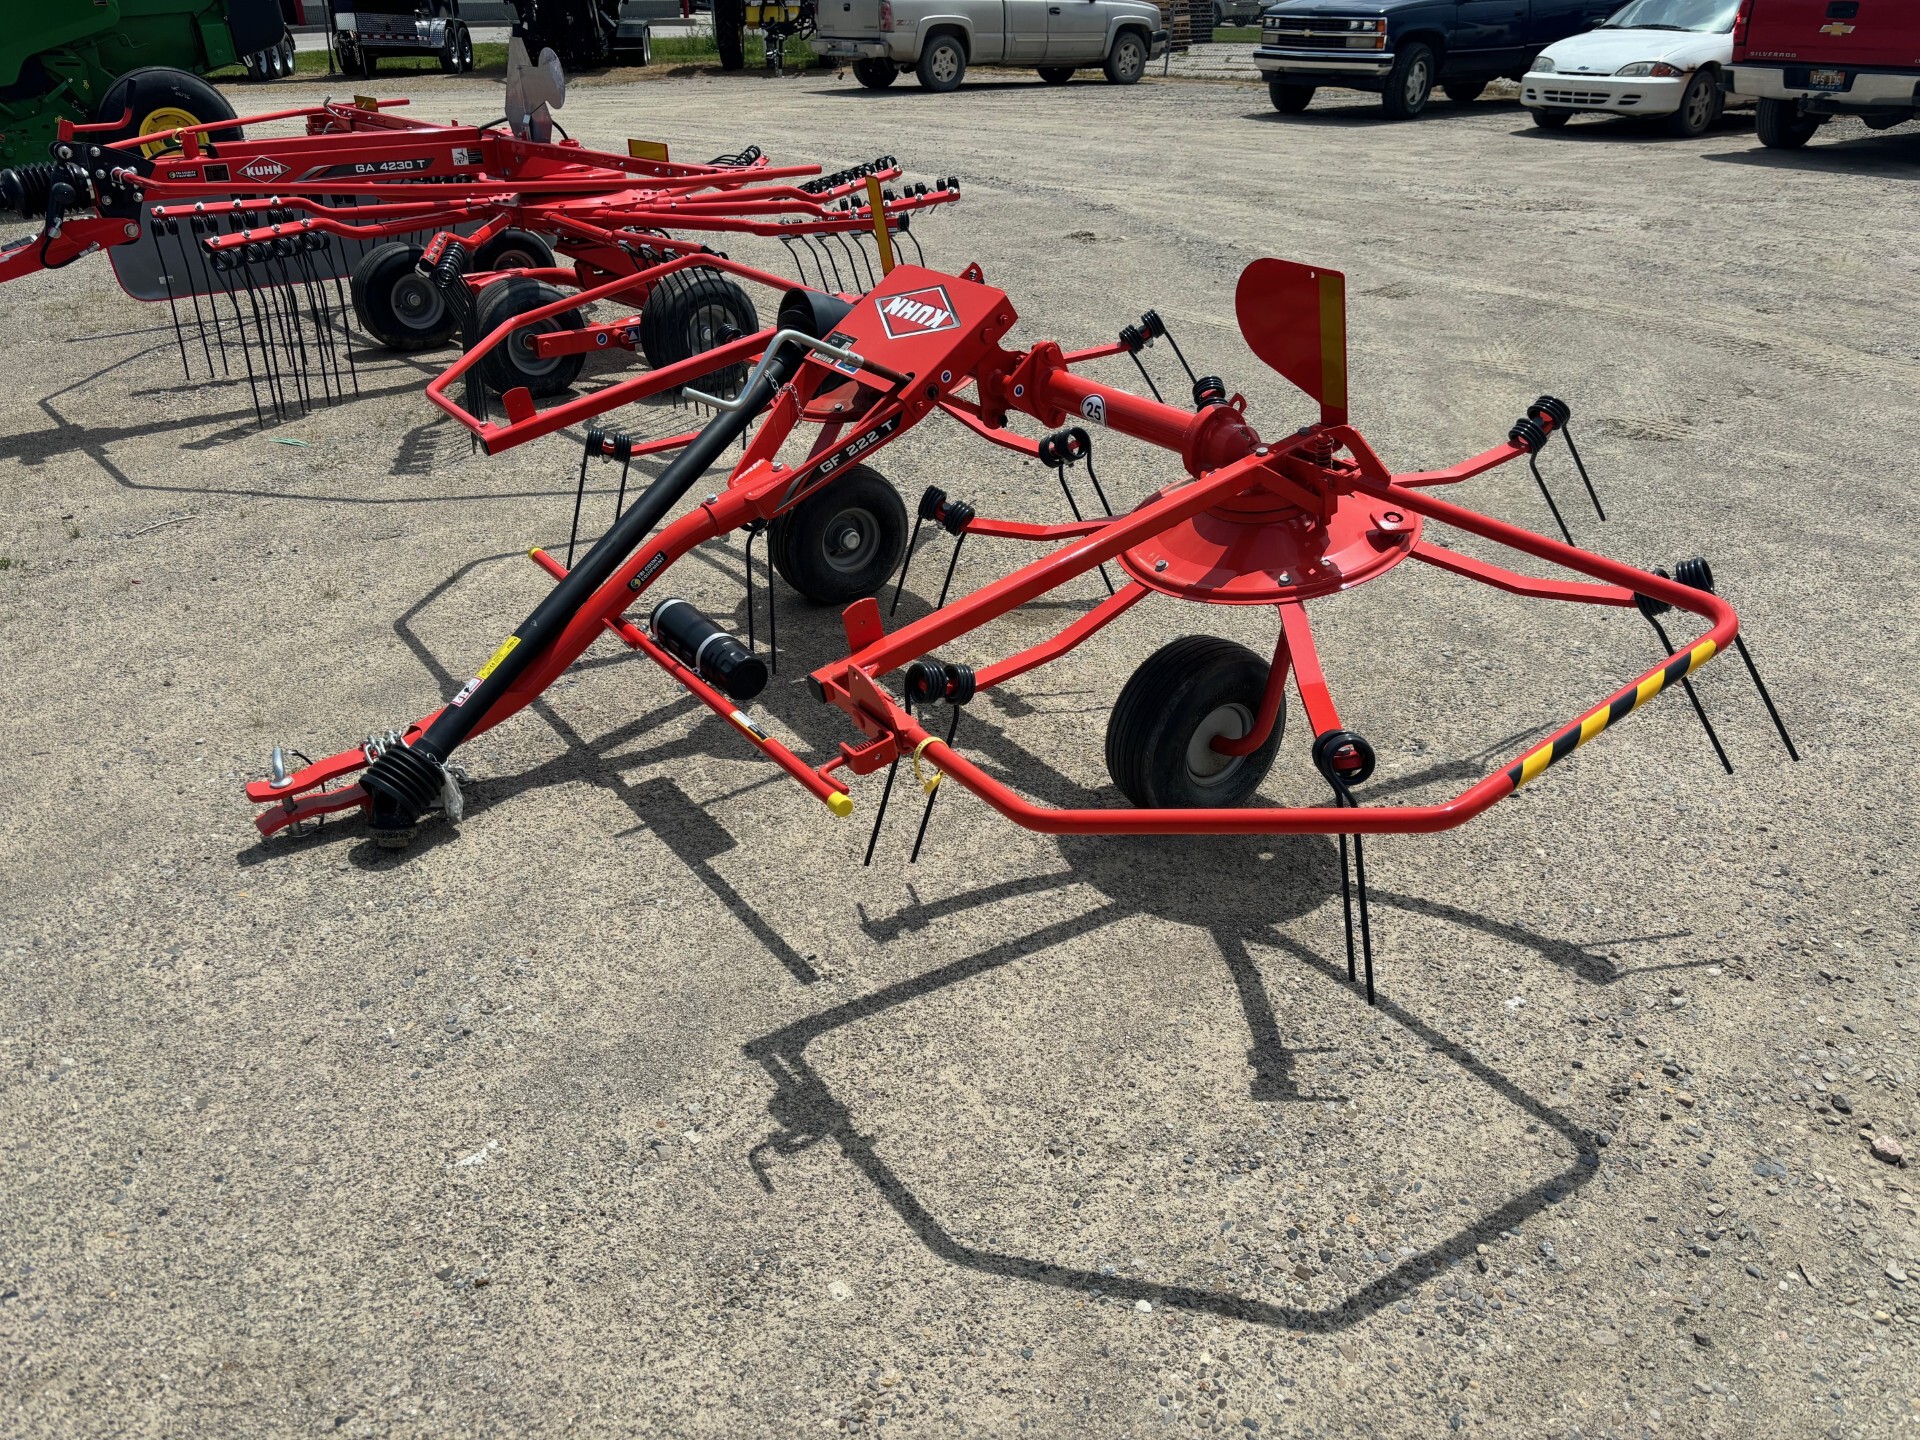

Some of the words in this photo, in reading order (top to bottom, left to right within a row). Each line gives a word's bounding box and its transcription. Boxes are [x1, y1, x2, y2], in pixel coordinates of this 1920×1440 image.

[246, 165, 282, 177] KUHN
[356, 163, 375, 173] GA
[380, 160, 413, 172] 4230
[416, 159, 426, 168] T
[883, 296, 951, 329] KUHN
[1086, 402, 1102, 420] 25
[819, 453, 840, 473] GF
[845, 430, 880, 457] 222
[881, 419, 893, 432] T
[636, 570, 646, 579] TRI
[644, 552, 663, 571] COUNTY
[640, 556, 665, 582] EQUIPMENT
